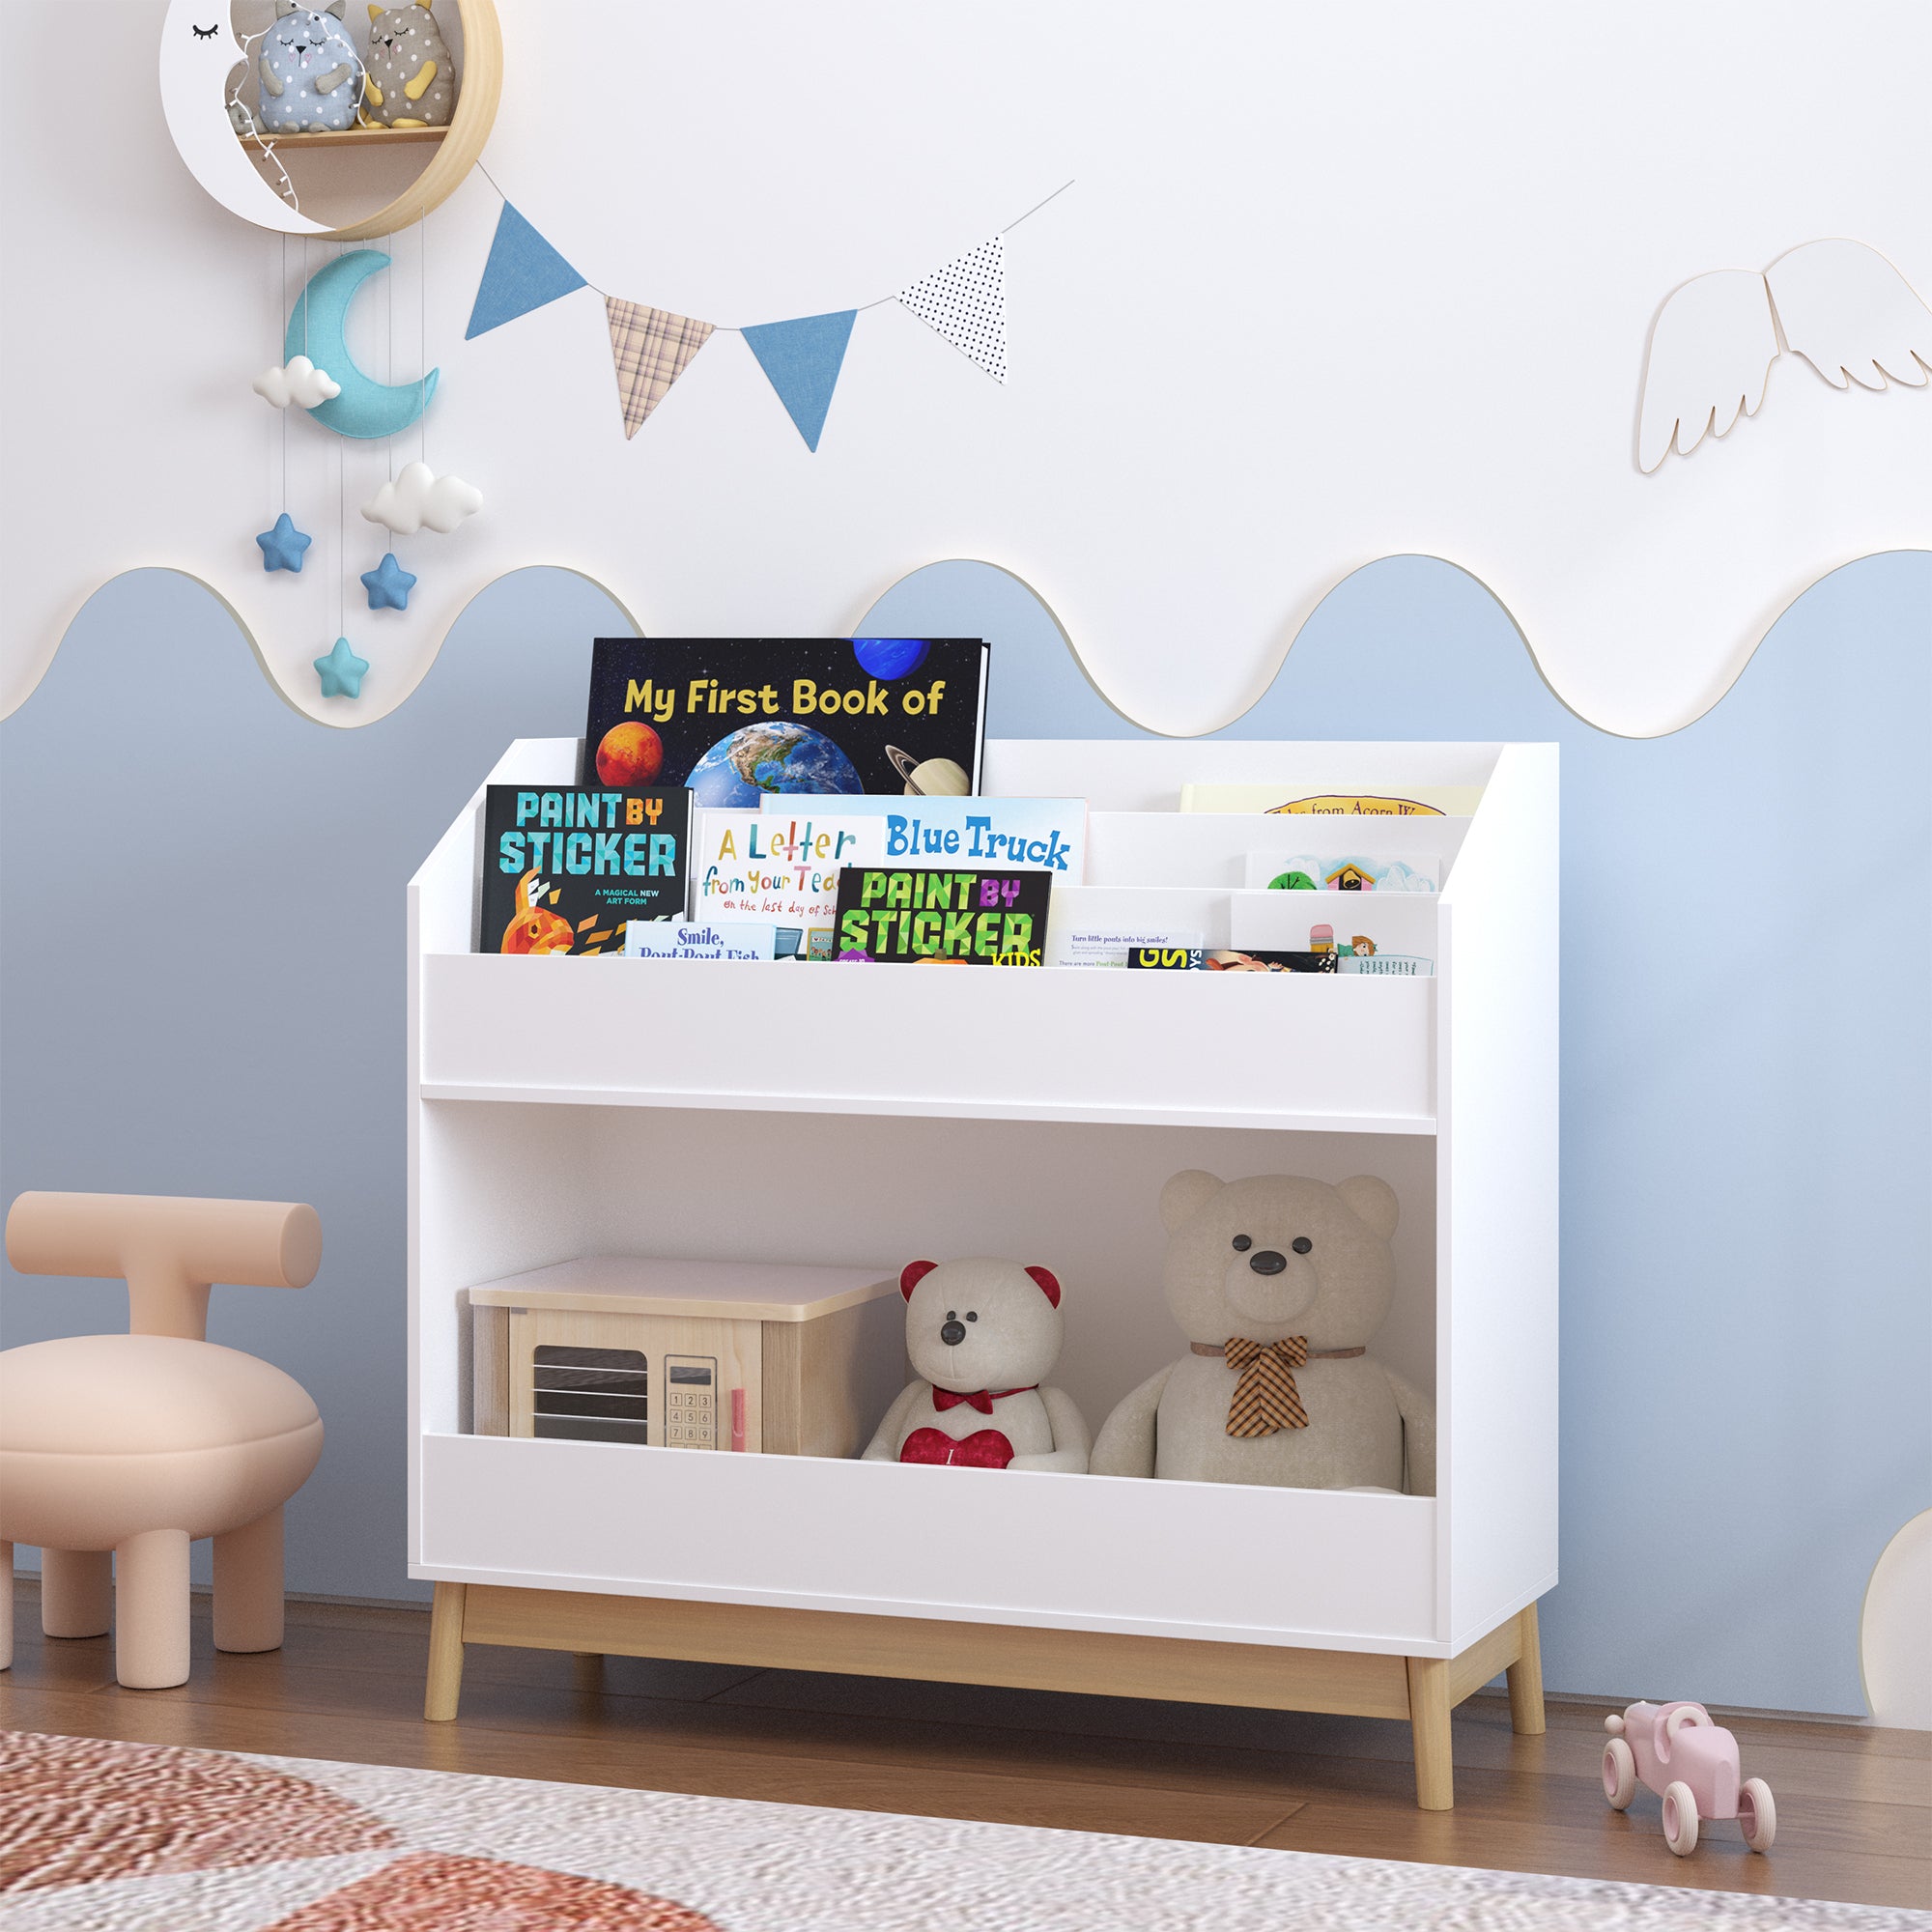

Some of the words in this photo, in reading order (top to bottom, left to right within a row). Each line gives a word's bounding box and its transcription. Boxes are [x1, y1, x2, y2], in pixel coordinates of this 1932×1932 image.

[624, 678, 675, 723] My
[687, 678, 780, 714] First
[792, 678, 889, 716] Book
[901, 680, 946, 715] of
[516, 791, 622, 828] PAINT
[625, 798, 664, 826] BY
[498, 831, 676, 877] STICKER
[718, 829, 737, 861] A
[749, 821, 857, 862] Letter
[887, 814, 960, 856] Blue
[965, 815, 1071, 870] Truck
[702, 866, 745, 896] from
[861, 871, 978, 910] PAINT
[979, 879, 1021, 908] BY
[739, 898, 756, 912] the
[761, 897, 782, 913] last
[788, 901, 805, 918] day
[809, 905, 820, 917] of
[677, 926, 724, 947] Smile,
[839, 909, 1034, 957] STICKER
[991, 948, 1041, 967] KIDS
